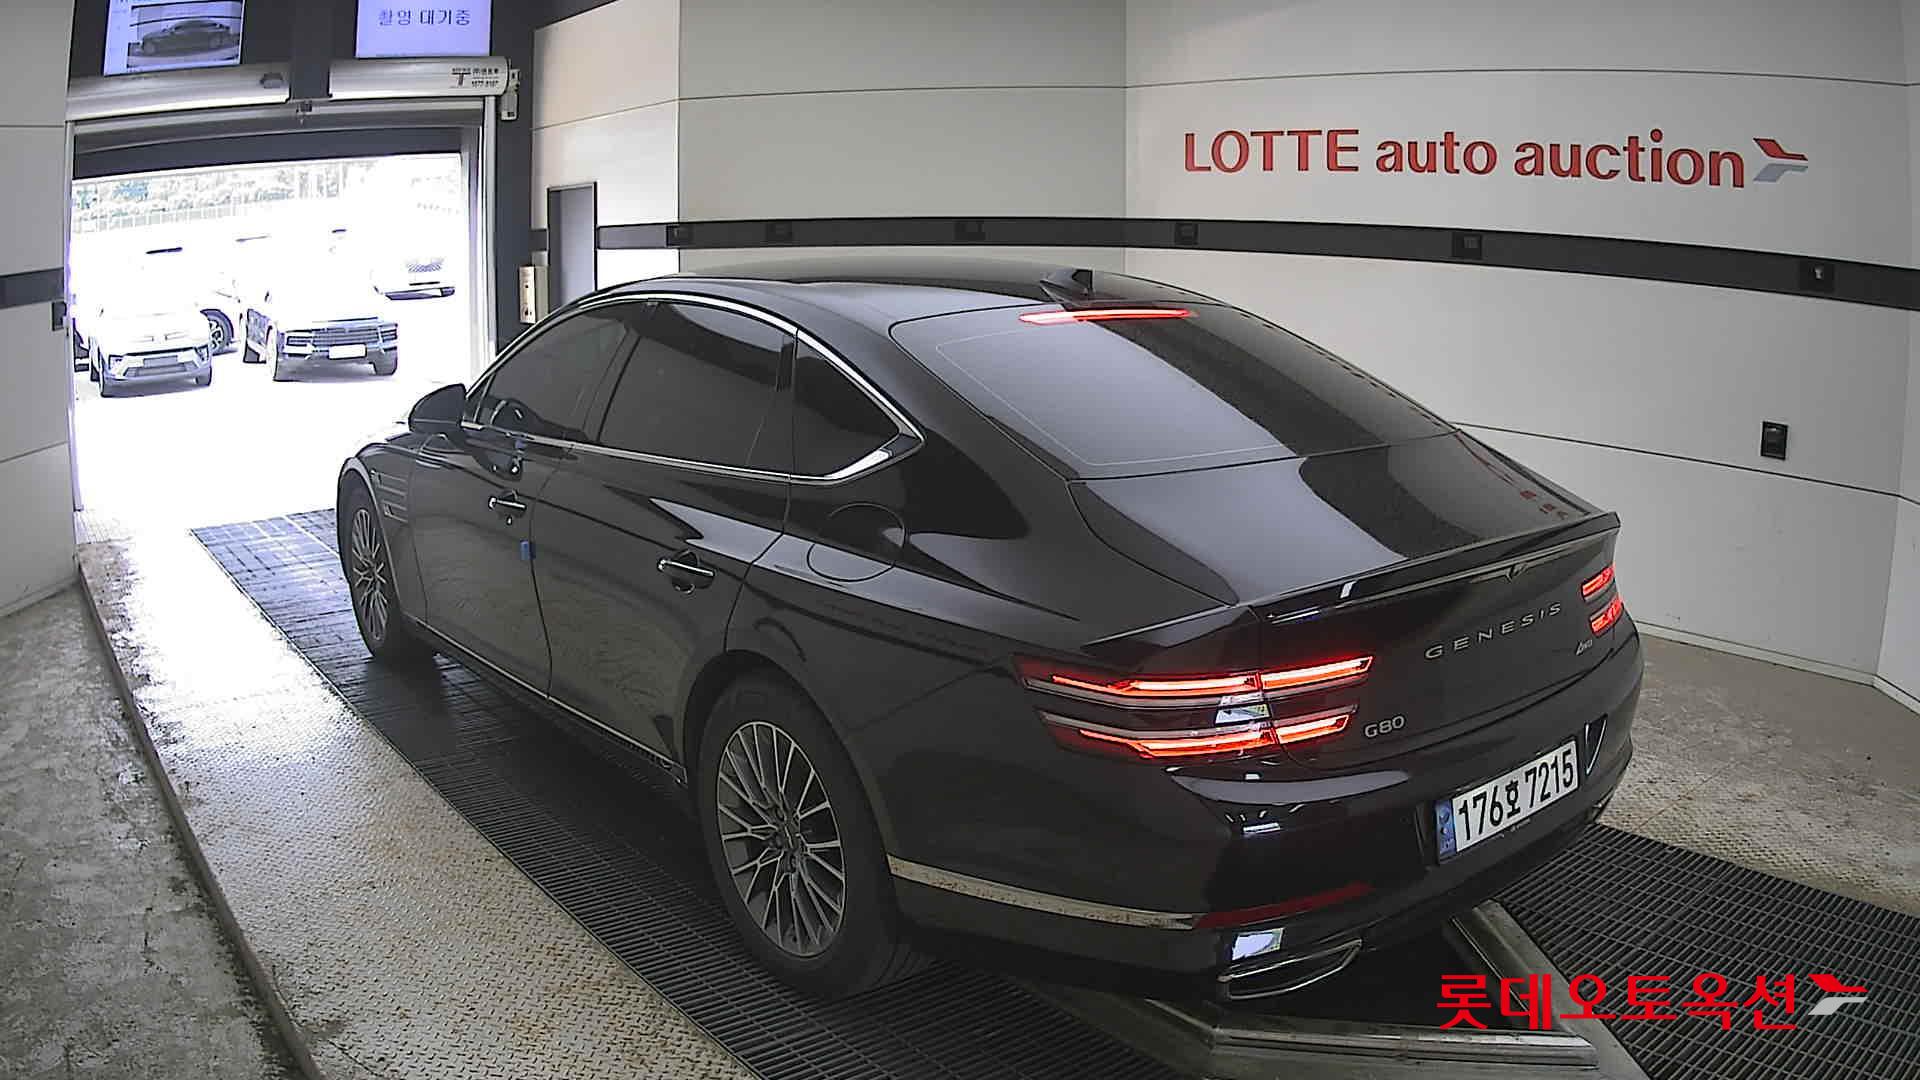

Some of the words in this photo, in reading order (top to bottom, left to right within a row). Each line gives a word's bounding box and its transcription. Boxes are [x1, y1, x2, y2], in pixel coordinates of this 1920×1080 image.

[420, 8, 470, 26] 대기중
[1184, 129, 1359, 174] LOTTE
[1376, 130, 1498, 177] auto
[1514, 128, 1746, 189] auction
[1424, 602, 1562, 660] GENESIS
[1364, 715, 1406, 739] G80
[1458, 780, 1521, 841] 176호
[1524, 748, 1574, 808] 7215
